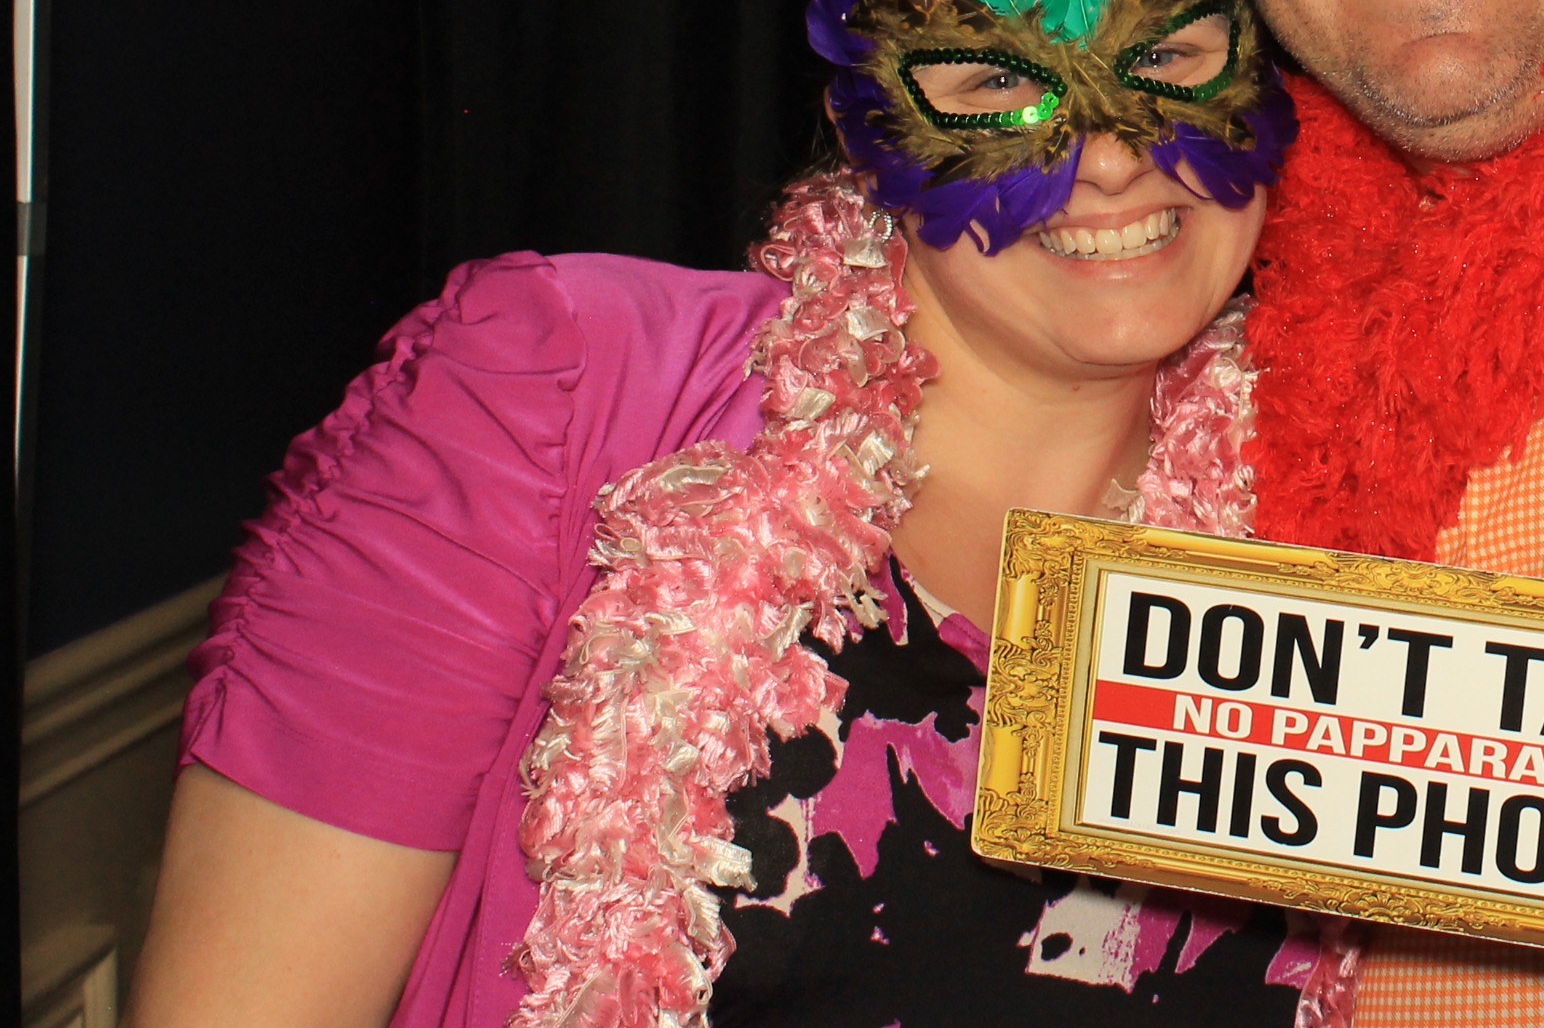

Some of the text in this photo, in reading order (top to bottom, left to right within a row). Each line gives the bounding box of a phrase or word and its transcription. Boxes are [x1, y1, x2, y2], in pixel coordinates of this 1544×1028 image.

[1122, 591, 1454, 718] DON'T
[1172, 693, 1253, 739] NO
[1098, 731, 1322, 847] THIS
